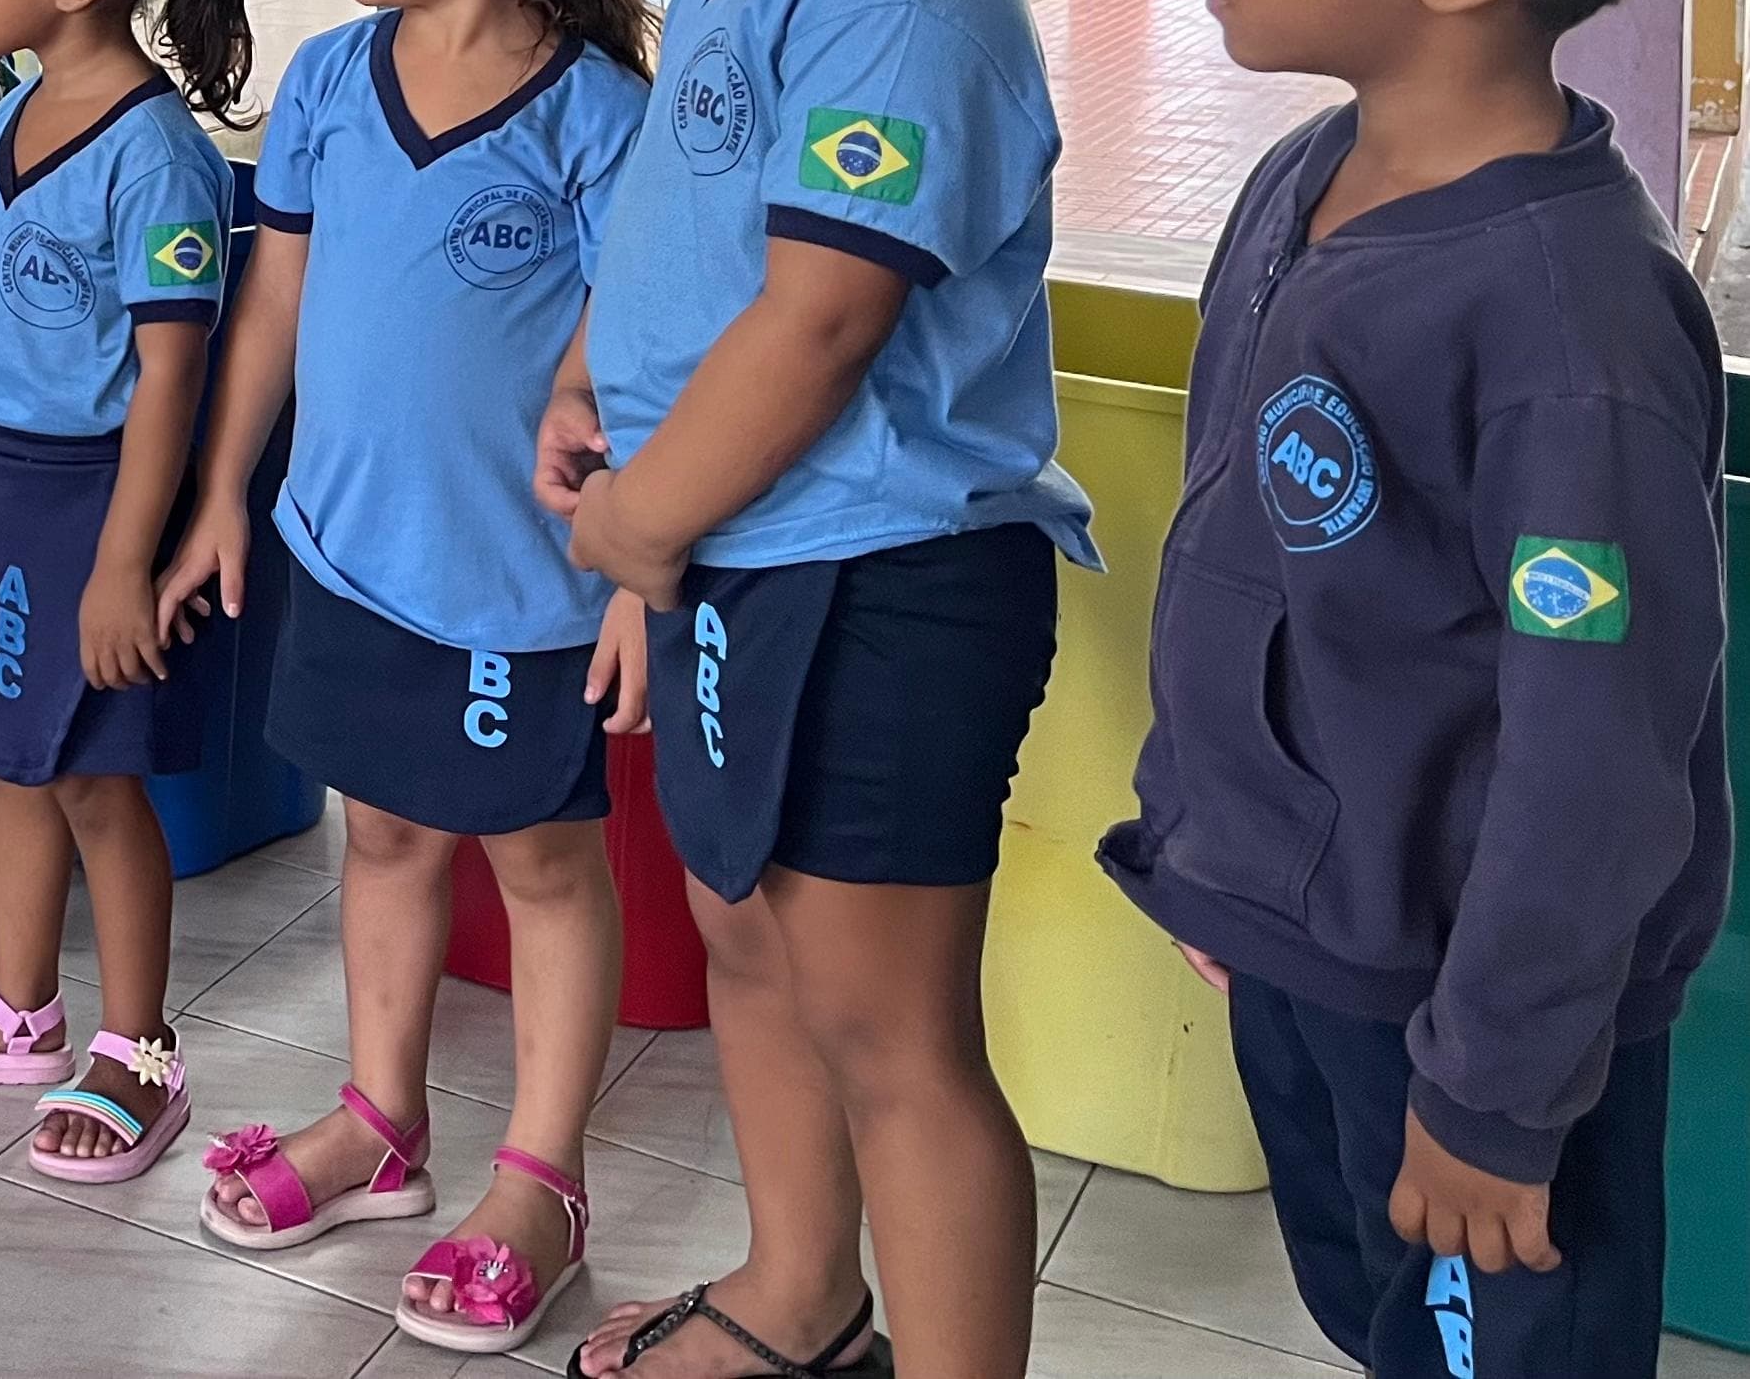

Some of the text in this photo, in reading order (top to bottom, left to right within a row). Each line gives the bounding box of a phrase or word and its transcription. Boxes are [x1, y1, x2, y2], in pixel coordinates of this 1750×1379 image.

[452, 189, 519, 264] CENTRO MUNICIPAL DE
[469, 222, 533, 250] ABC
[1271, 431, 1341, 499] ABC
[695, 601, 727, 769] ABC
